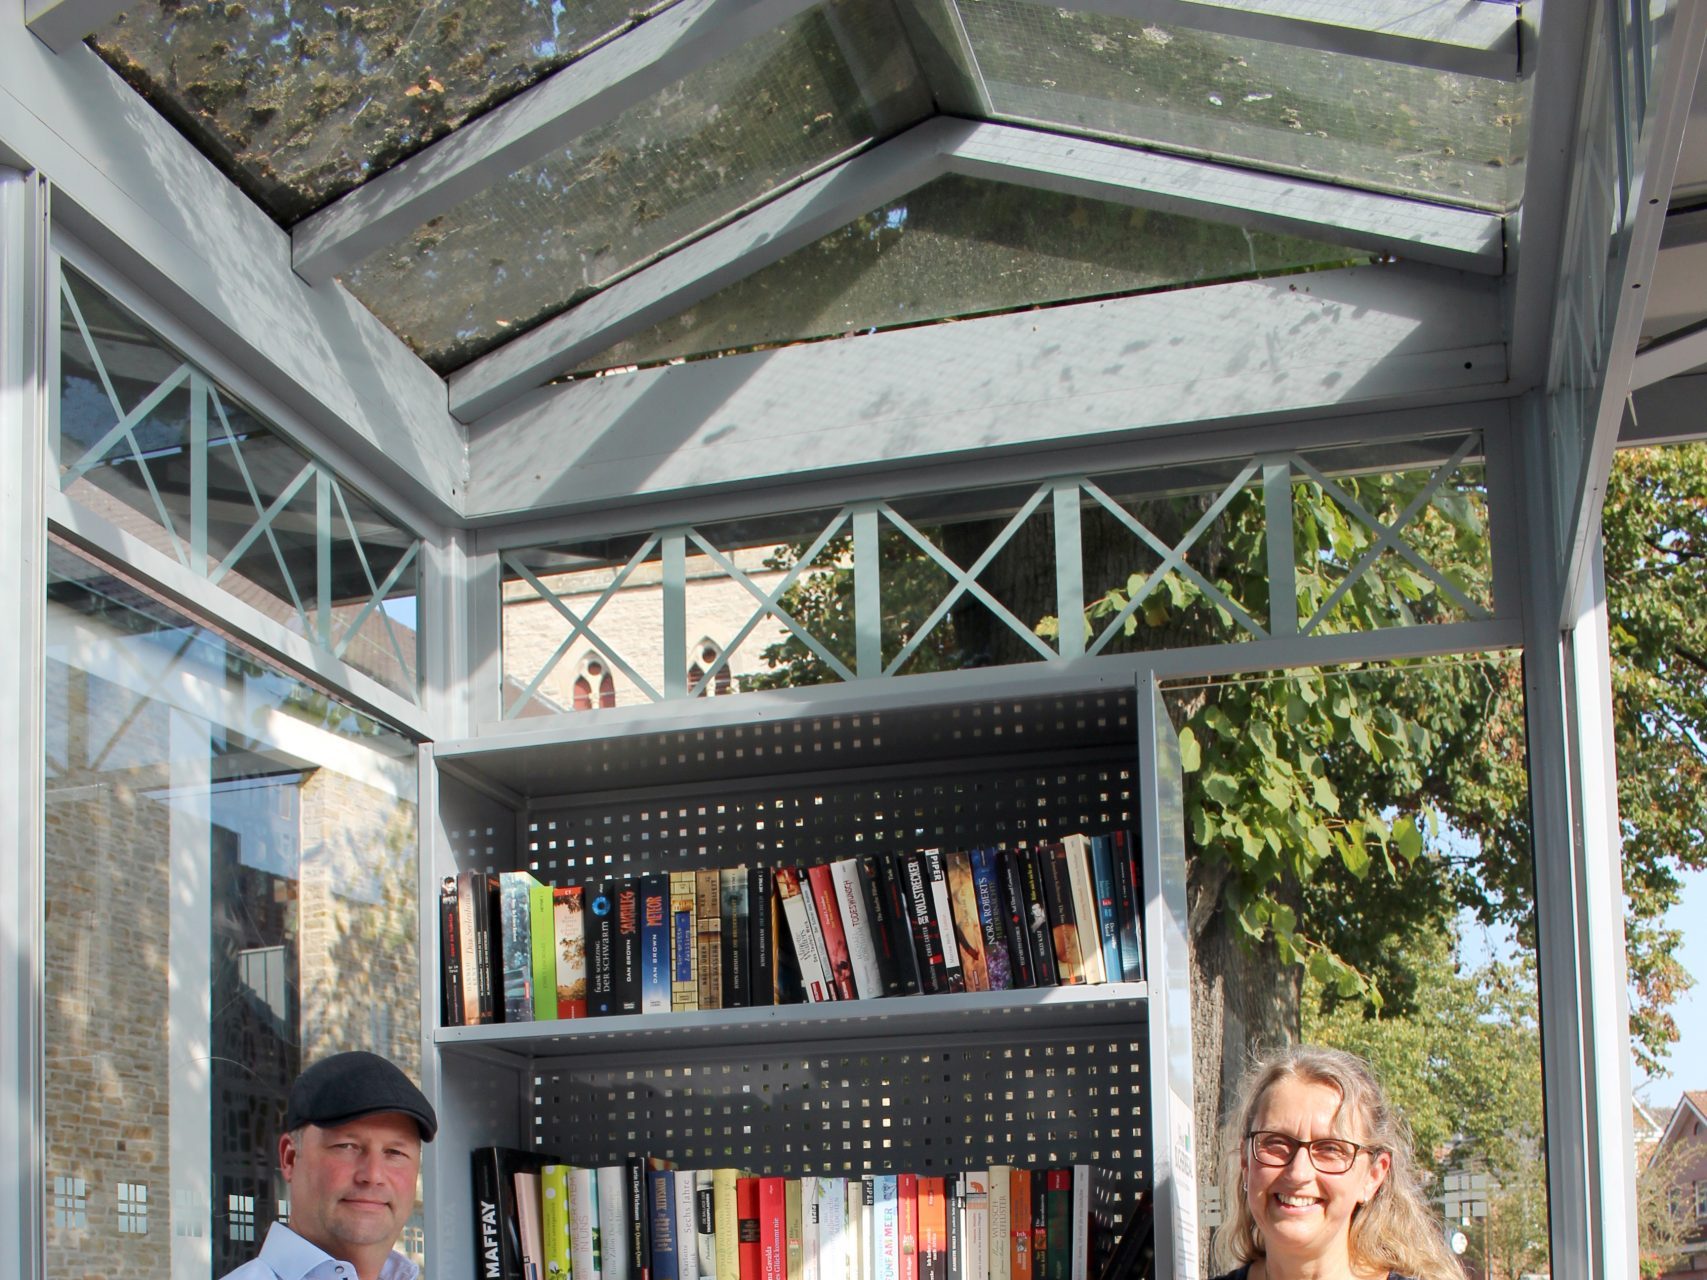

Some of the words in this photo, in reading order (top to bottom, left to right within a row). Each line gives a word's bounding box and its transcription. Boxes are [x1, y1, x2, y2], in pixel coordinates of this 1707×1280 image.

[932, 855, 943, 881] PIPER
[907, 861, 929, 917] VOLLSTRECKER
[978, 877, 992, 917] ROBERTS
[619, 891, 636, 935] SAKRILEG
[645, 895, 662, 927] METEOR
[843, 880, 862, 927] TODESWUNSCH
[922, 927, 931, 943] CARTER
[983, 917, 996, 945] NORA
[925, 943, 933, 957] CHRIS
[569, 1176, 577, 1207] ATEM
[682, 1179, 692, 1204] Jahre
[865, 1180, 873, 1205] PIPER
[579, 1215, 589, 1239] UNS
[683, 1207, 692, 1233] Sechs
[882, 1207, 893, 1237] MEER
[991, 1200, 999, 1238] WUNSCH
[481, 1200, 501, 1279] MAFFAY
[883, 1239, 894, 1257] AM
[765, 1246, 774, 1272] Gavalda
[773, 1252, 782, 1273] Glück
